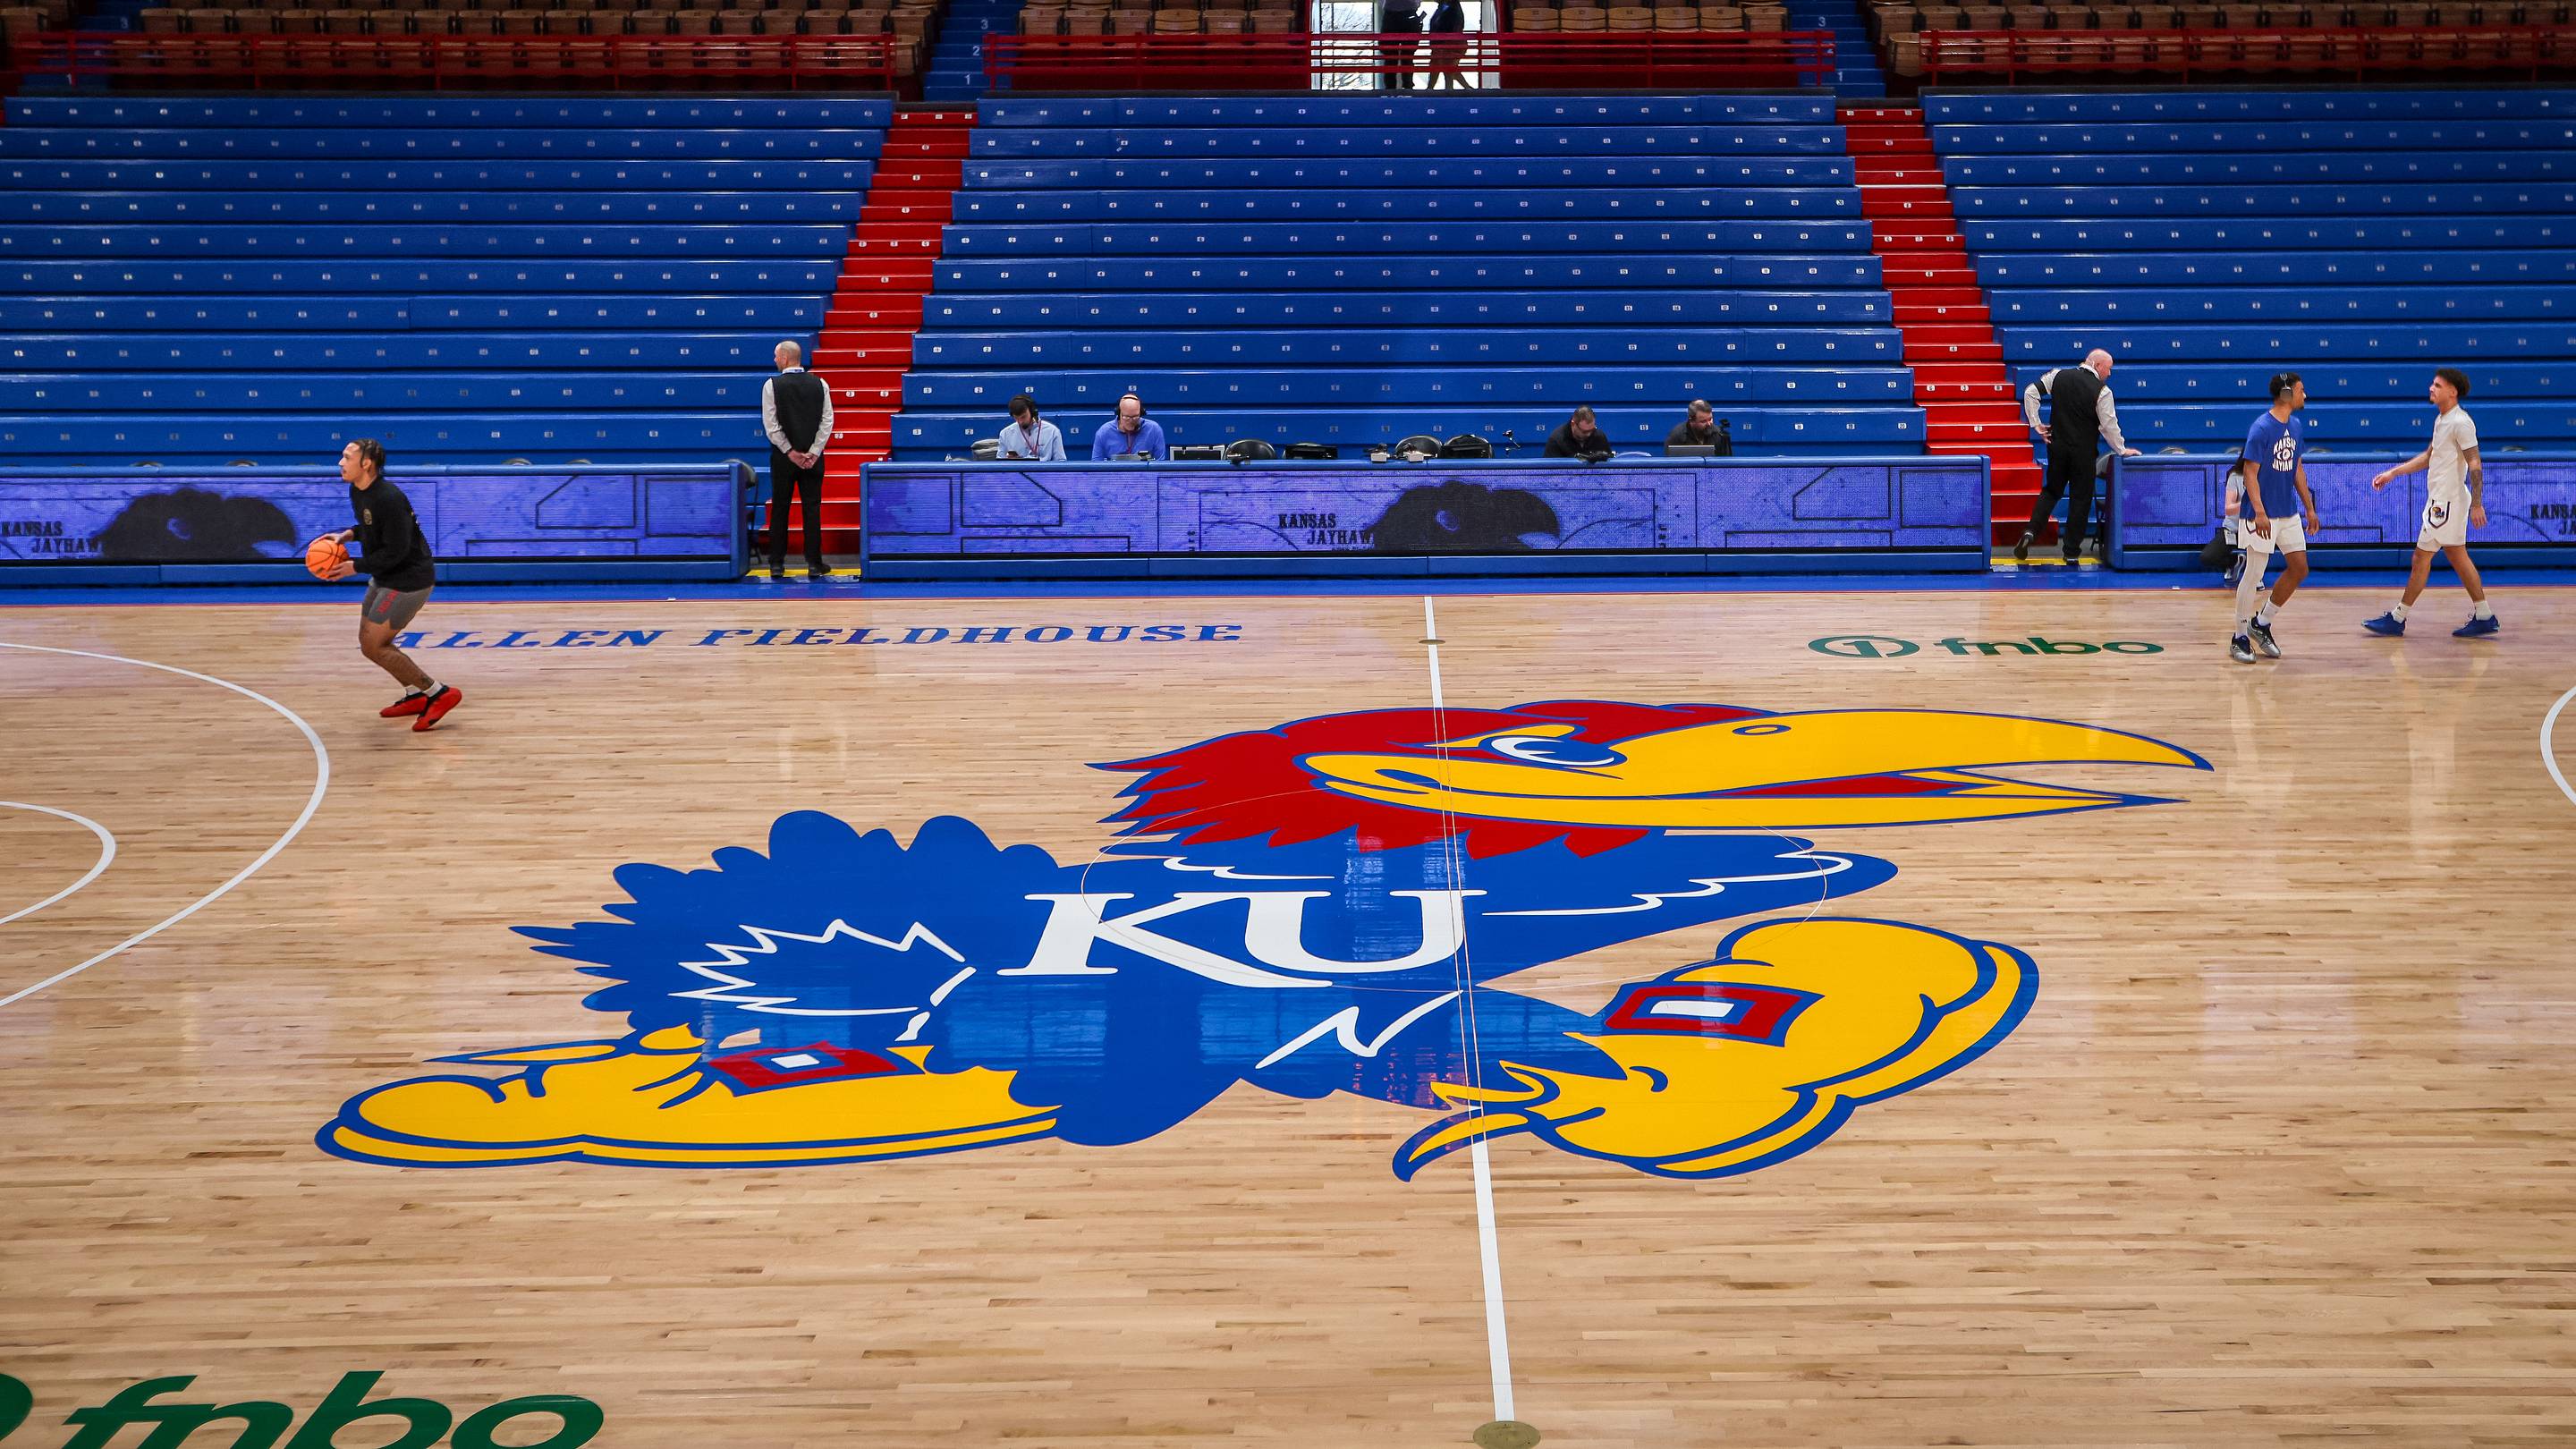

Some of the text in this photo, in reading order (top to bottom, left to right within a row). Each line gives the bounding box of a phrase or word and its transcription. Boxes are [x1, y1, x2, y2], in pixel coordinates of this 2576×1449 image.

[980, 19, 988, 30] 3
[1818, 16, 1826, 27] 3
[972, 45, 980, 56] 2
[964, 73, 970, 85] 1
[1837, 71, 1843, 81] 1
[2, 521, 63, 536] KANSAS
[1278, 513, 1336, 529] KANSAS
[392, 624, 1244, 649] ALLEN FIELDHOUSE
[1934, 637, 2165, 656] fnbo
[996, 890, 1488, 988] KU
[63, 1370, 605, 1449] fnbo
